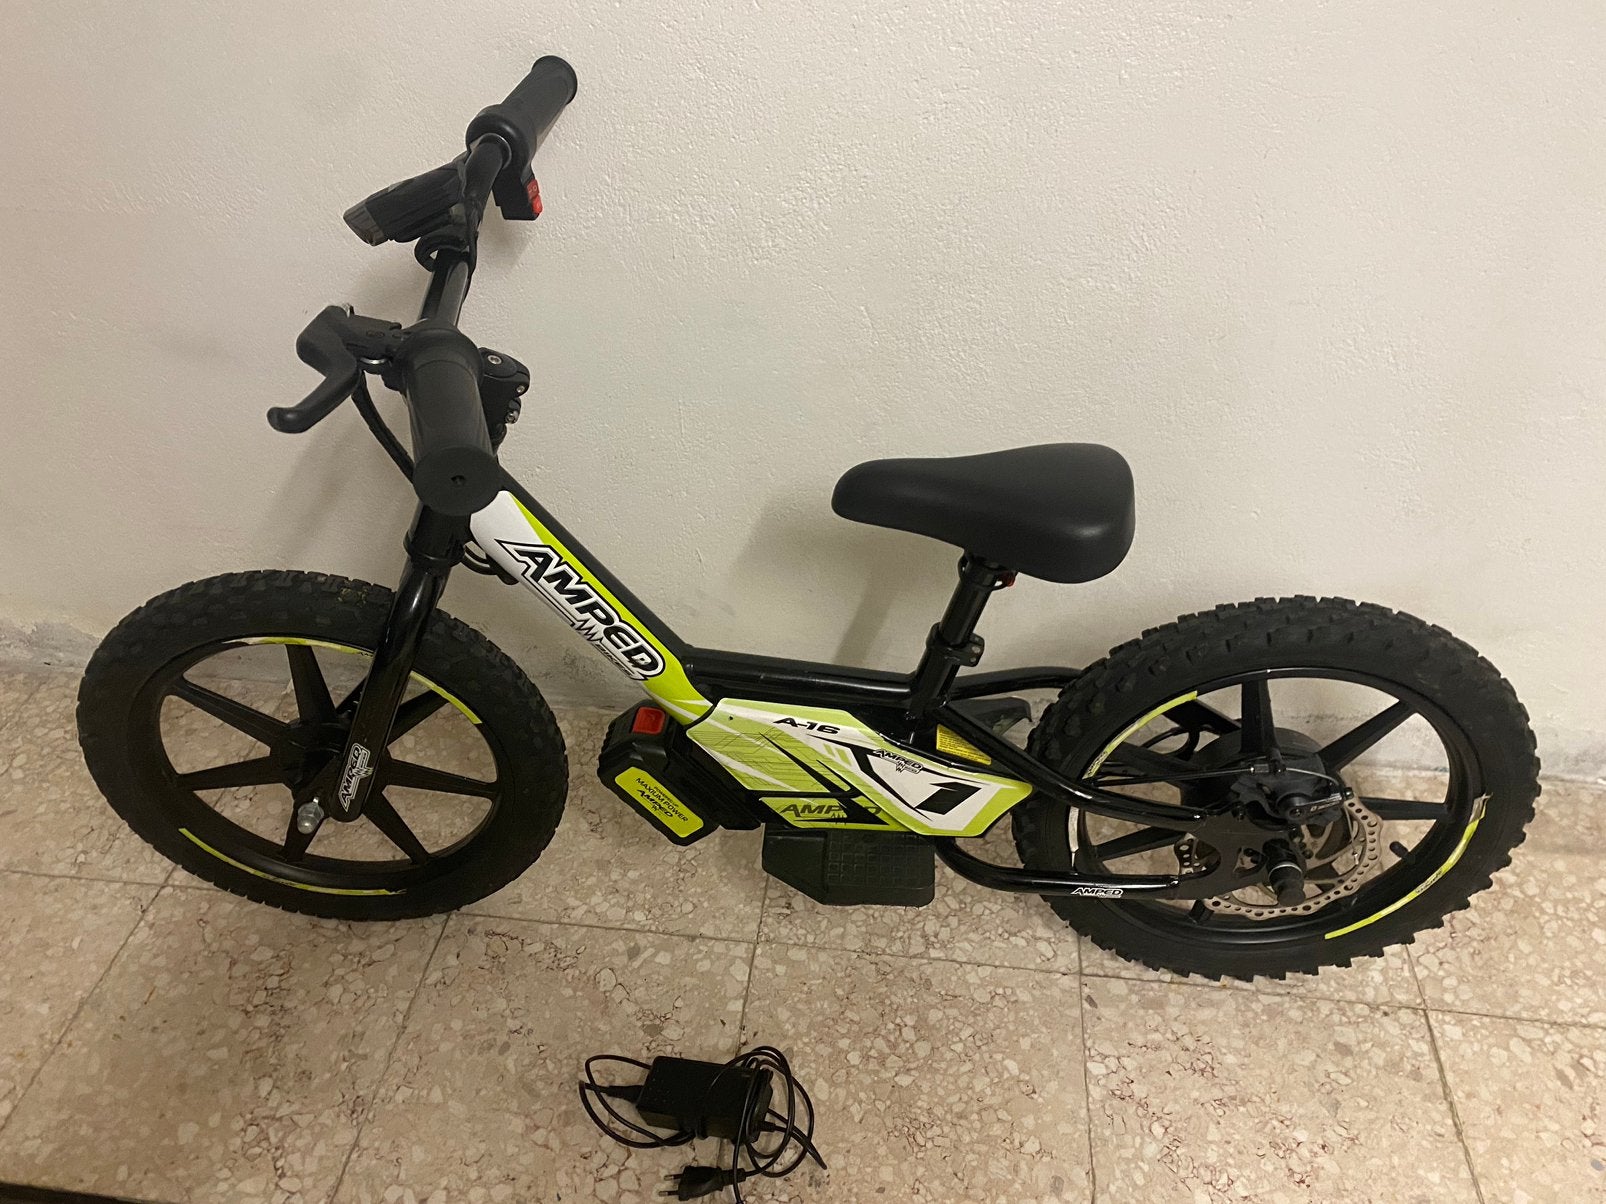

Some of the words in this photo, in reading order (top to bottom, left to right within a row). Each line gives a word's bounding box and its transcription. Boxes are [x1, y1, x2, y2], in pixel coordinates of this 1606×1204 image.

[510, 546, 661, 675] AMPED
[773, 717, 841, 735] A-16
[873, 750, 922, 769] AMPED
[341, 745, 363, 806] AMPED
[635, 777, 665, 802] MAXIUM
[663, 800, 689, 822] POWER
[636, 789, 674, 817] AMPED
[1072, 887, 1123, 896] AMPED
